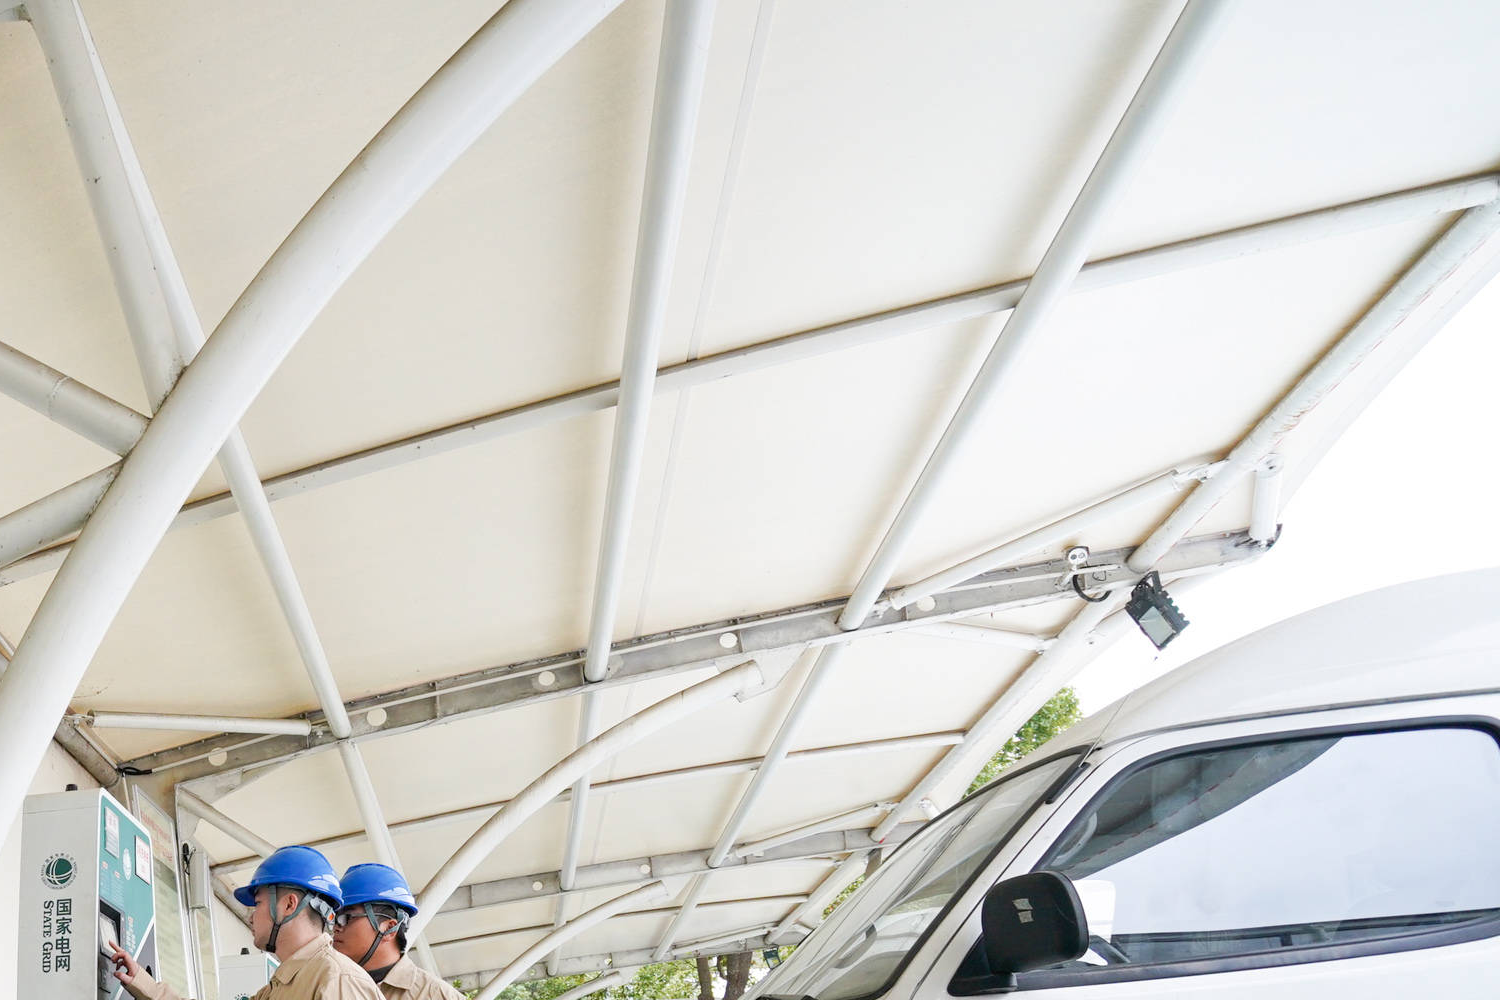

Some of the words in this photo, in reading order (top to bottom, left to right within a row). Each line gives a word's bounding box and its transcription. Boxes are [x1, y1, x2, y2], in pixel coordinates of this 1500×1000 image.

[43, 900, 54, 938] STATE
[55, 898, 72, 973] 国家电网
[42, 941, 53, 974] GRID
